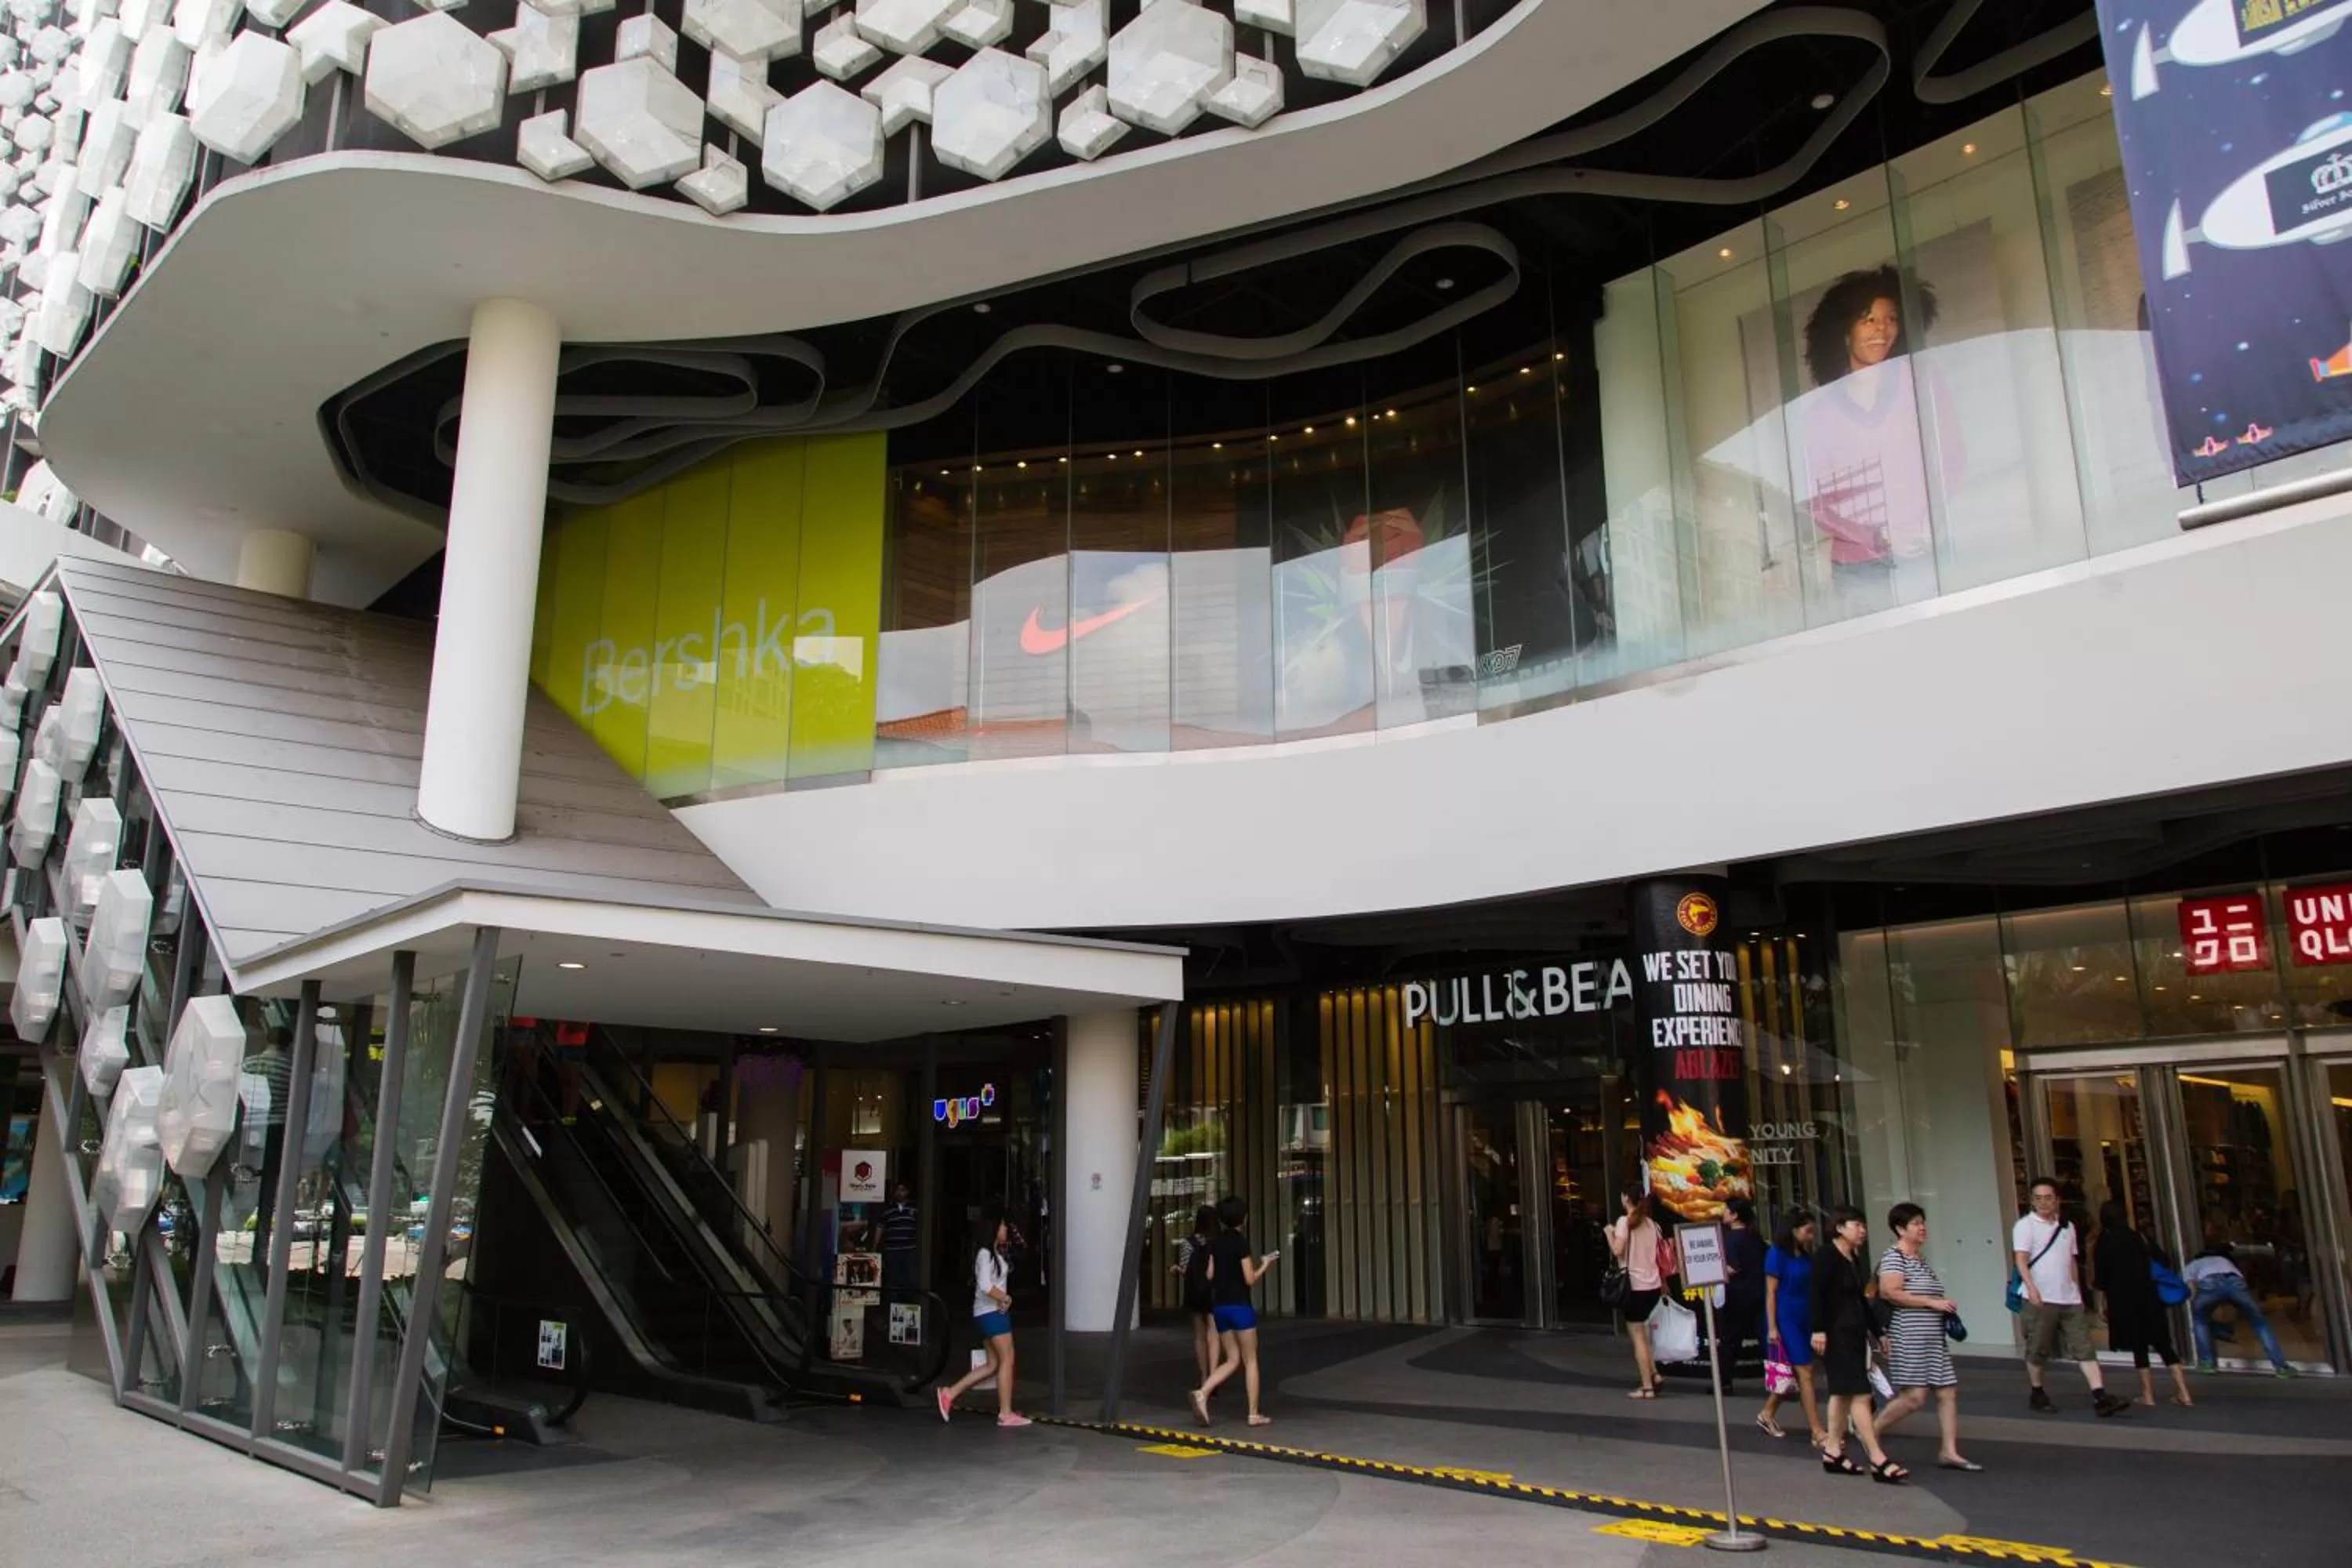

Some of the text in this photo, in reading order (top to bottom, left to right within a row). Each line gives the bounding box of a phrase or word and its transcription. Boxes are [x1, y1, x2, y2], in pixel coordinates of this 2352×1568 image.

[581, 597, 836, 717] Bershka
[1642, 952, 1673, 982] WE
[1675, 950, 1711, 980] SET
[1673, 982, 1733, 1013] DINING
[1748, 1120, 1817, 1139] YOUNG
